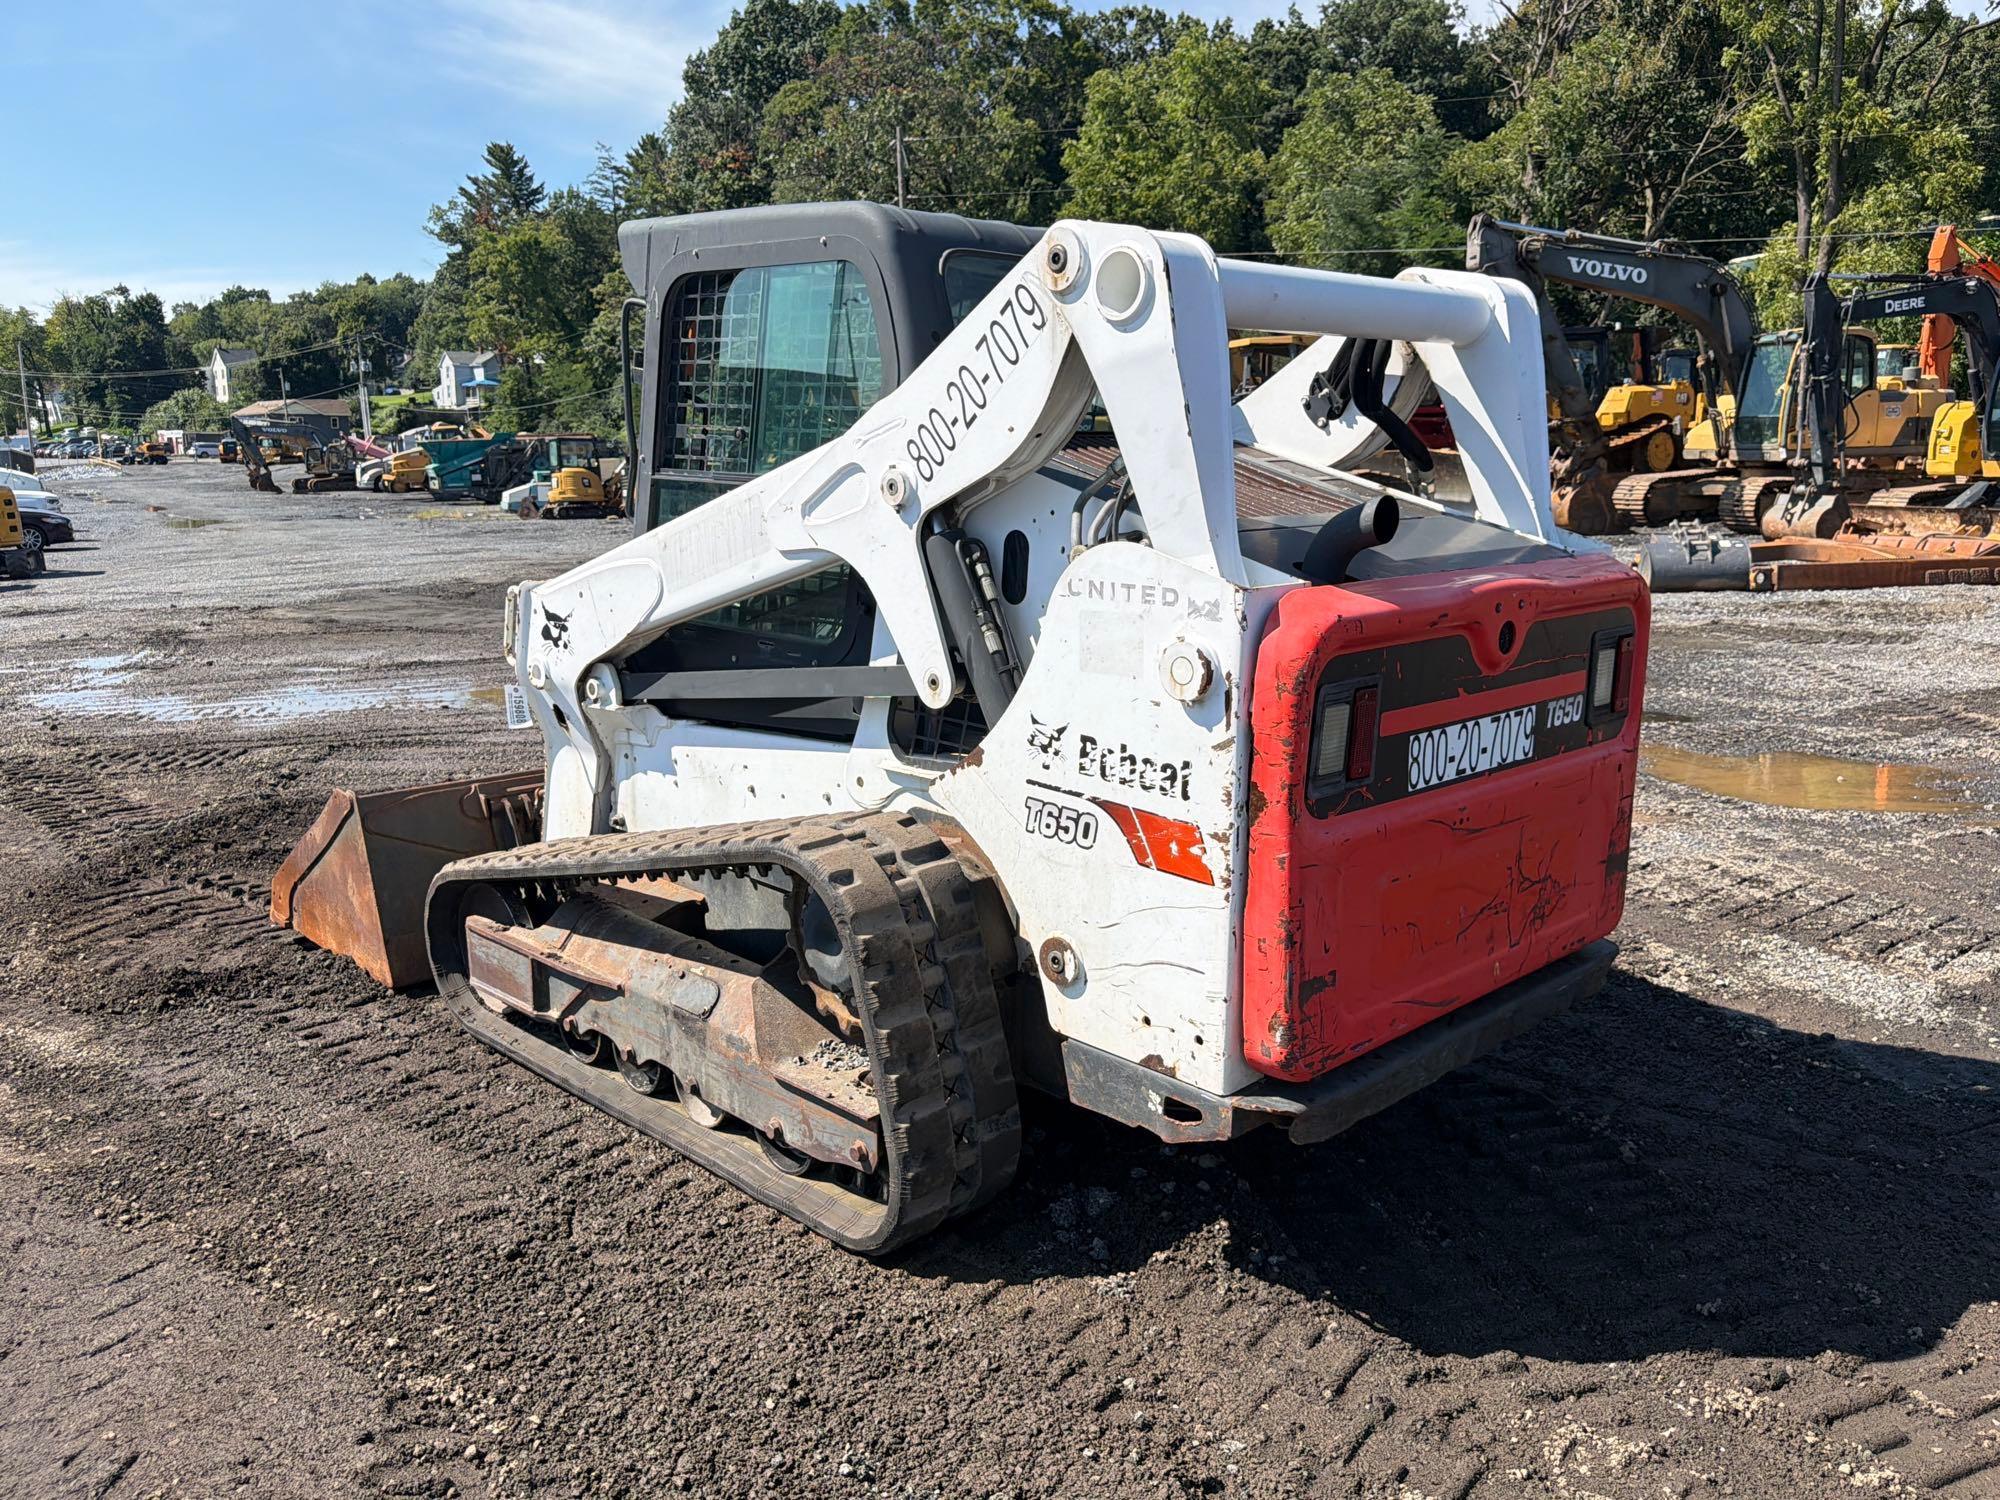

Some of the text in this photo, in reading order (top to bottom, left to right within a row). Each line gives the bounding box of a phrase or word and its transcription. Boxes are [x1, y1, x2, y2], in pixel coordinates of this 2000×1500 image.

[1567, 256, 1648, 284] VOLVO
[1885, 296, 1926, 313] DEERE
[906, 284, 1047, 482] 800-20-7079
[1067, 578, 1179, 607] UNITED
[1547, 694, 1584, 728] T650
[1079, 734, 1192, 801] Bobcat
[1409, 707, 1536, 790] 800-20-7079
[1025, 796, 1099, 850] T650
